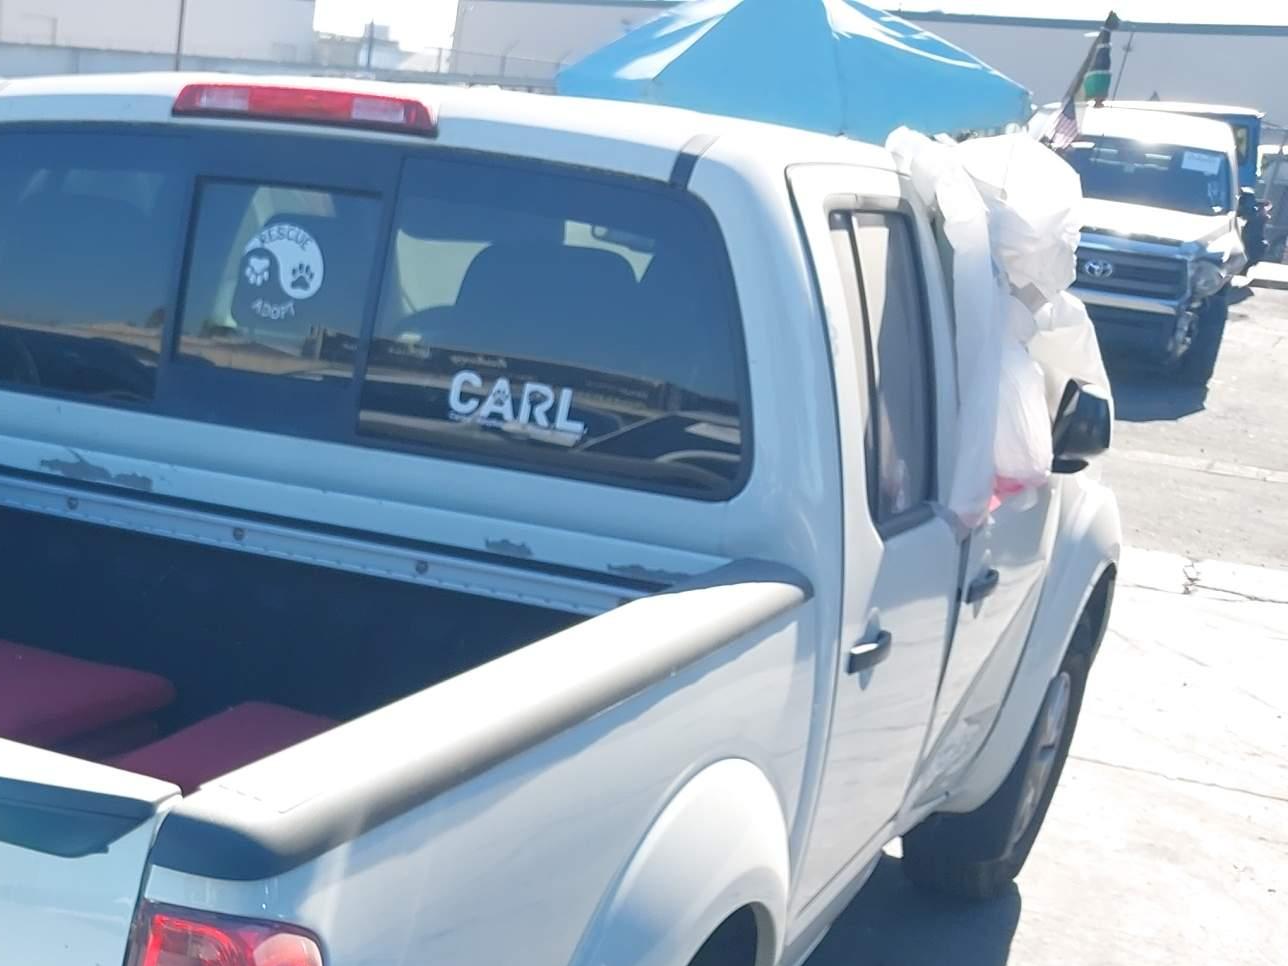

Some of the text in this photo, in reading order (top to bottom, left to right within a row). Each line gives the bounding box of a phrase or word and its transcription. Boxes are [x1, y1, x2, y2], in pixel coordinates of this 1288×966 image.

[259, 225, 312, 250] RESCUE
[252, 299, 295, 320] ADOPT
[449, 369, 586, 434] CARL
